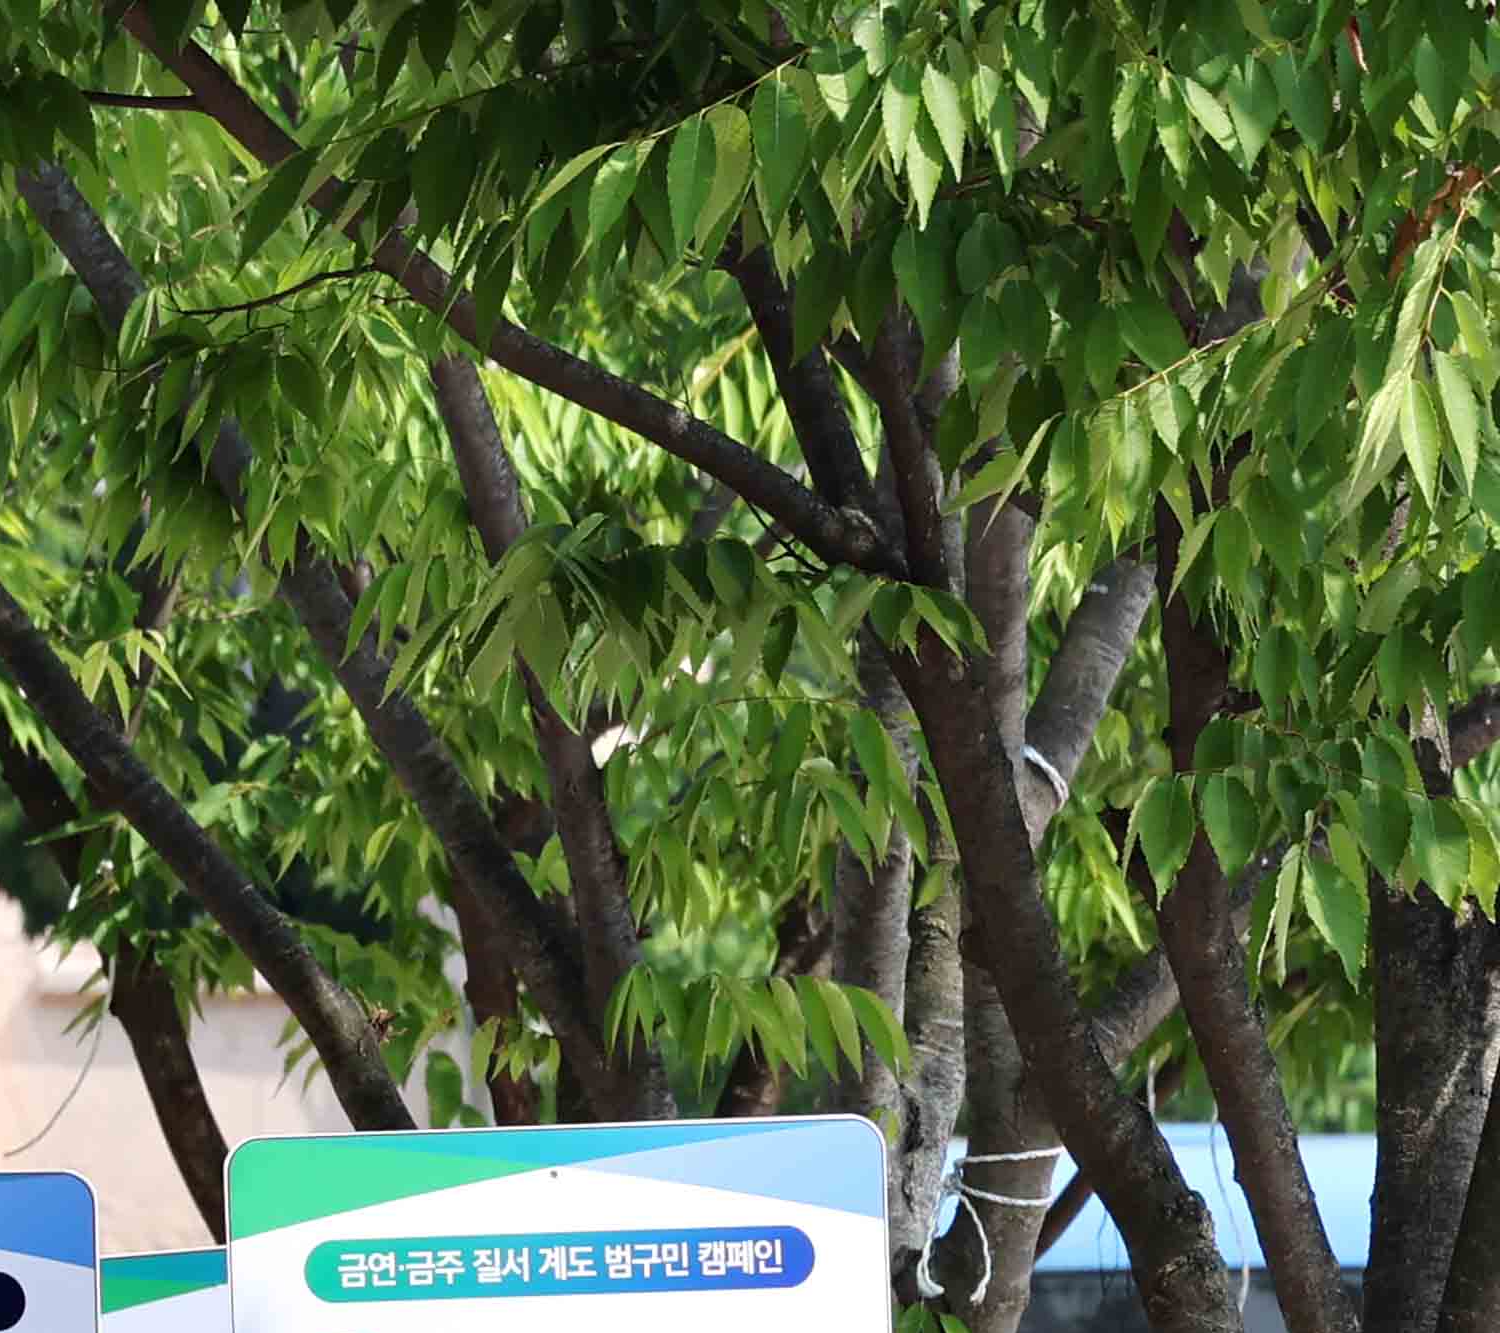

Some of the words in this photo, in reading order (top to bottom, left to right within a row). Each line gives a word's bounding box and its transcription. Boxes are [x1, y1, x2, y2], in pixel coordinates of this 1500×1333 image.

[338, 1253, 465, 1290] 금연·금주
[472, 1250, 530, 1285] 질서
[538, 1247, 595, 1282] 계도
[605, 1243, 690, 1281] 범구민
[698, 1238, 784, 1276] 캠페인
